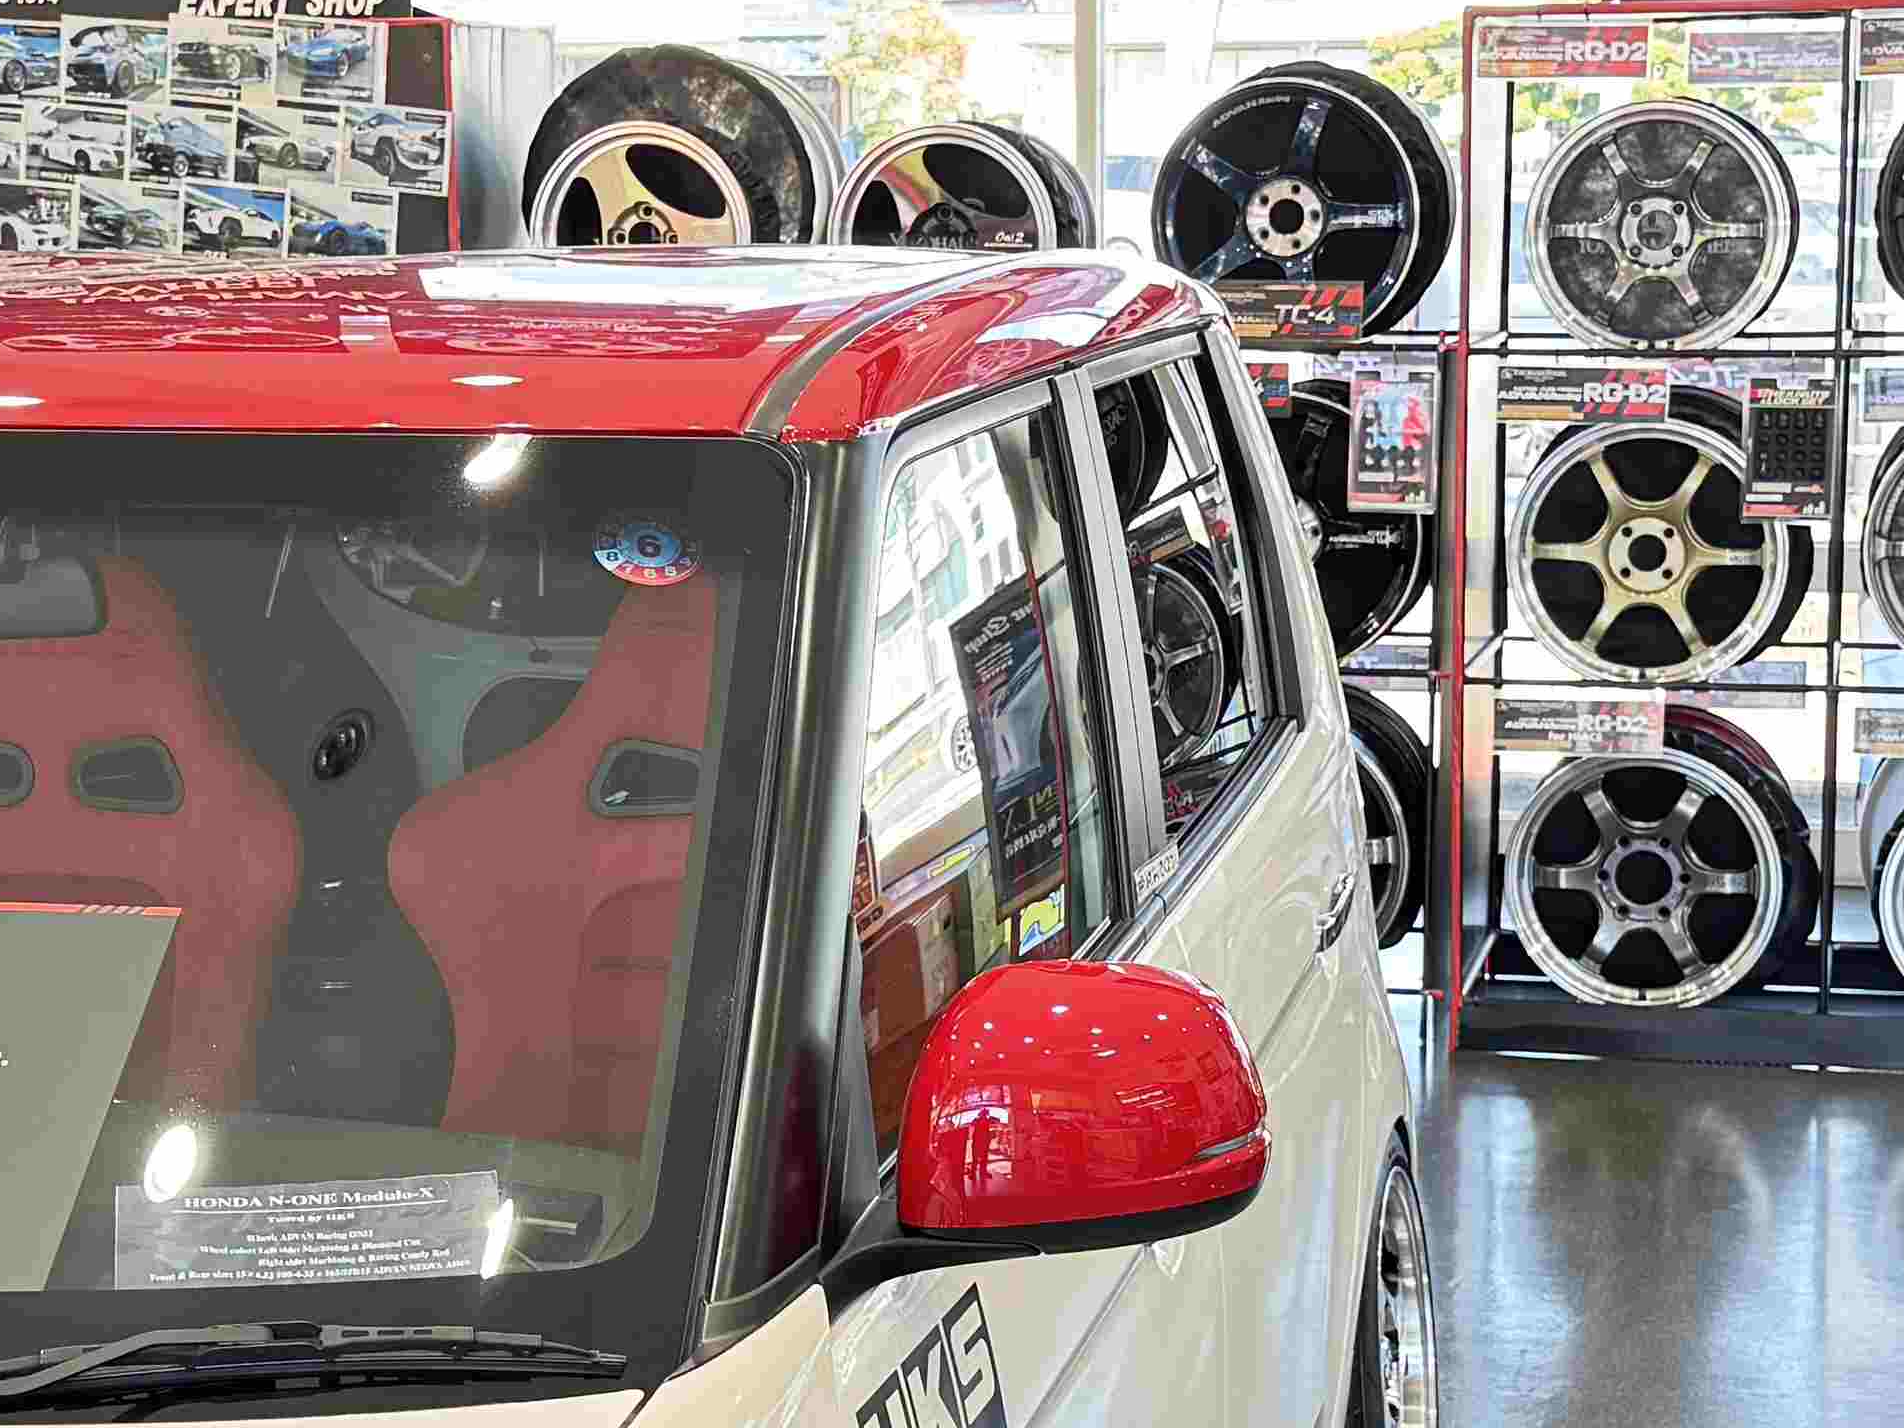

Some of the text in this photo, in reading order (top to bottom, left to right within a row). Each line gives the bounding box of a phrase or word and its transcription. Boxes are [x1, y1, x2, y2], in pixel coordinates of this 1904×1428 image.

[1274, 303, 1336, 325] TC-4
[1582, 382, 1668, 403] RG-D2
[183, 1195, 264, 1210] HONDA
[267, 1191, 338, 1208] N-ONE
